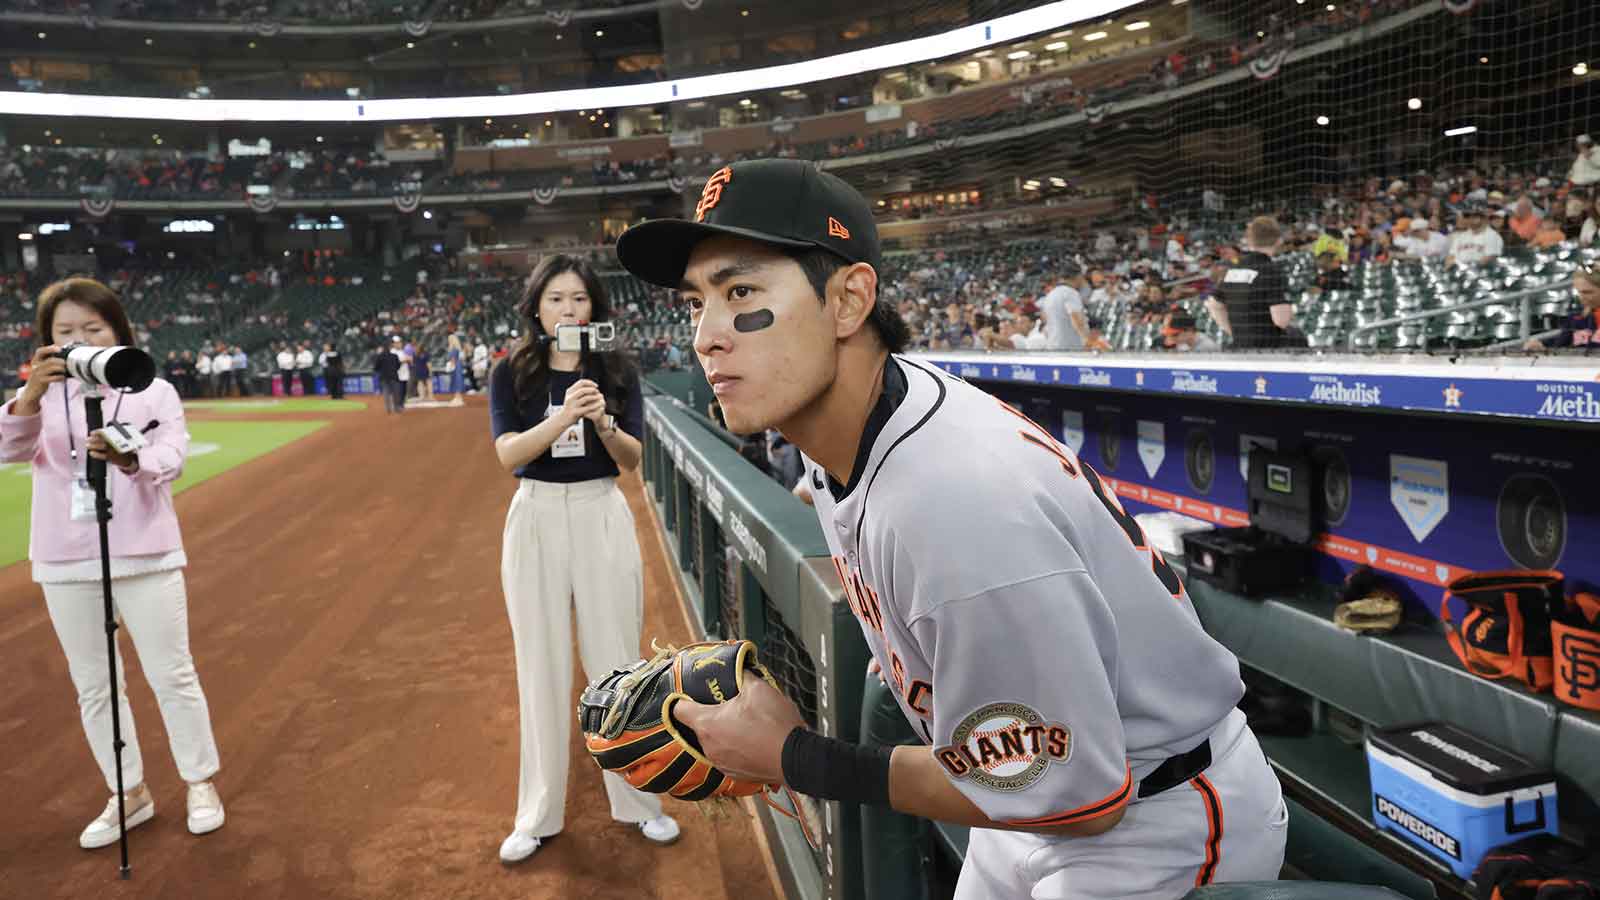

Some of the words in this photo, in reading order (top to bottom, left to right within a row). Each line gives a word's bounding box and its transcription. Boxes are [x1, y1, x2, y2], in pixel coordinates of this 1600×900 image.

[1310, 381, 1381, 405] Methodist
[1536, 384, 1585, 393] HOUSTON
[939, 724, 1069, 776] GIANTS
[1378, 797, 1457, 857] POWERADE
